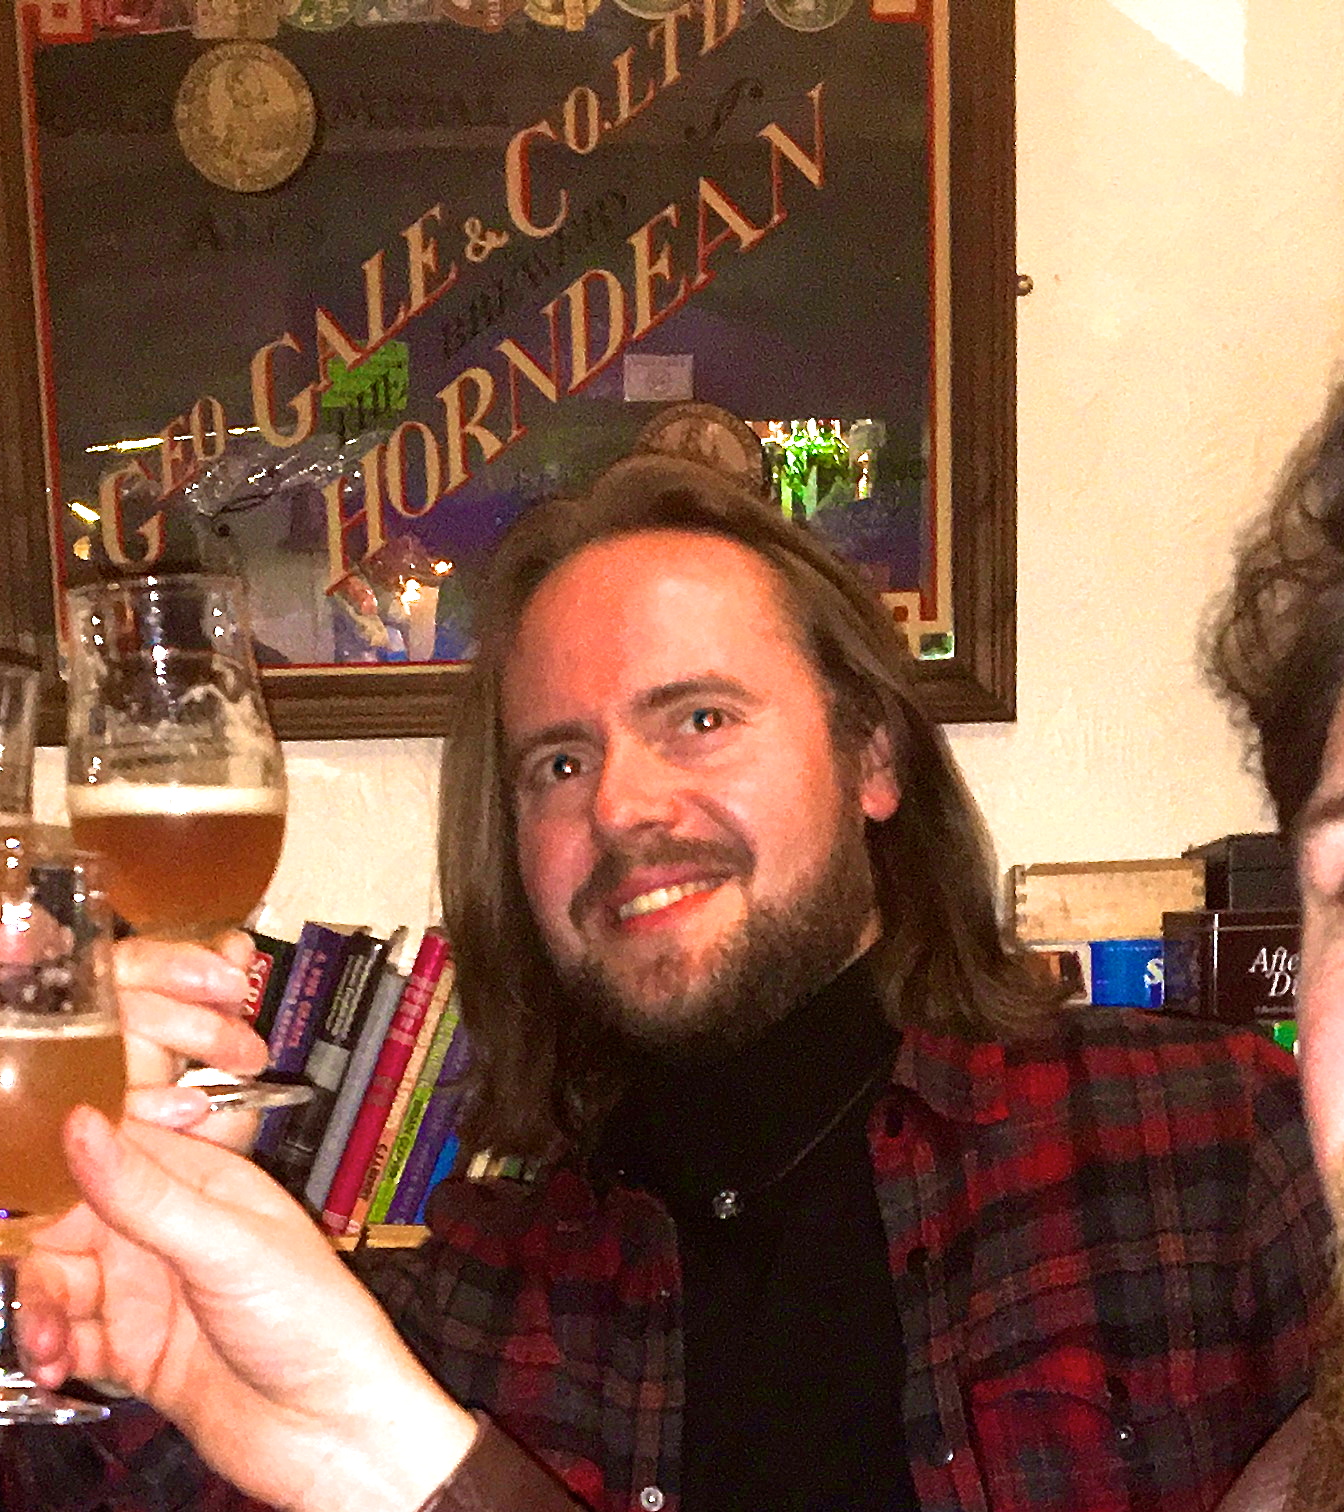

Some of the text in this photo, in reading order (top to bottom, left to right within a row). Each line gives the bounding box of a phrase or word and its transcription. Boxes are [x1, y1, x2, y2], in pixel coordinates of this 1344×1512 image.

[250, 203, 458, 448] GALE
[464, 216, 509, 263] &
[324, 83, 825, 597] HORNDEAN
